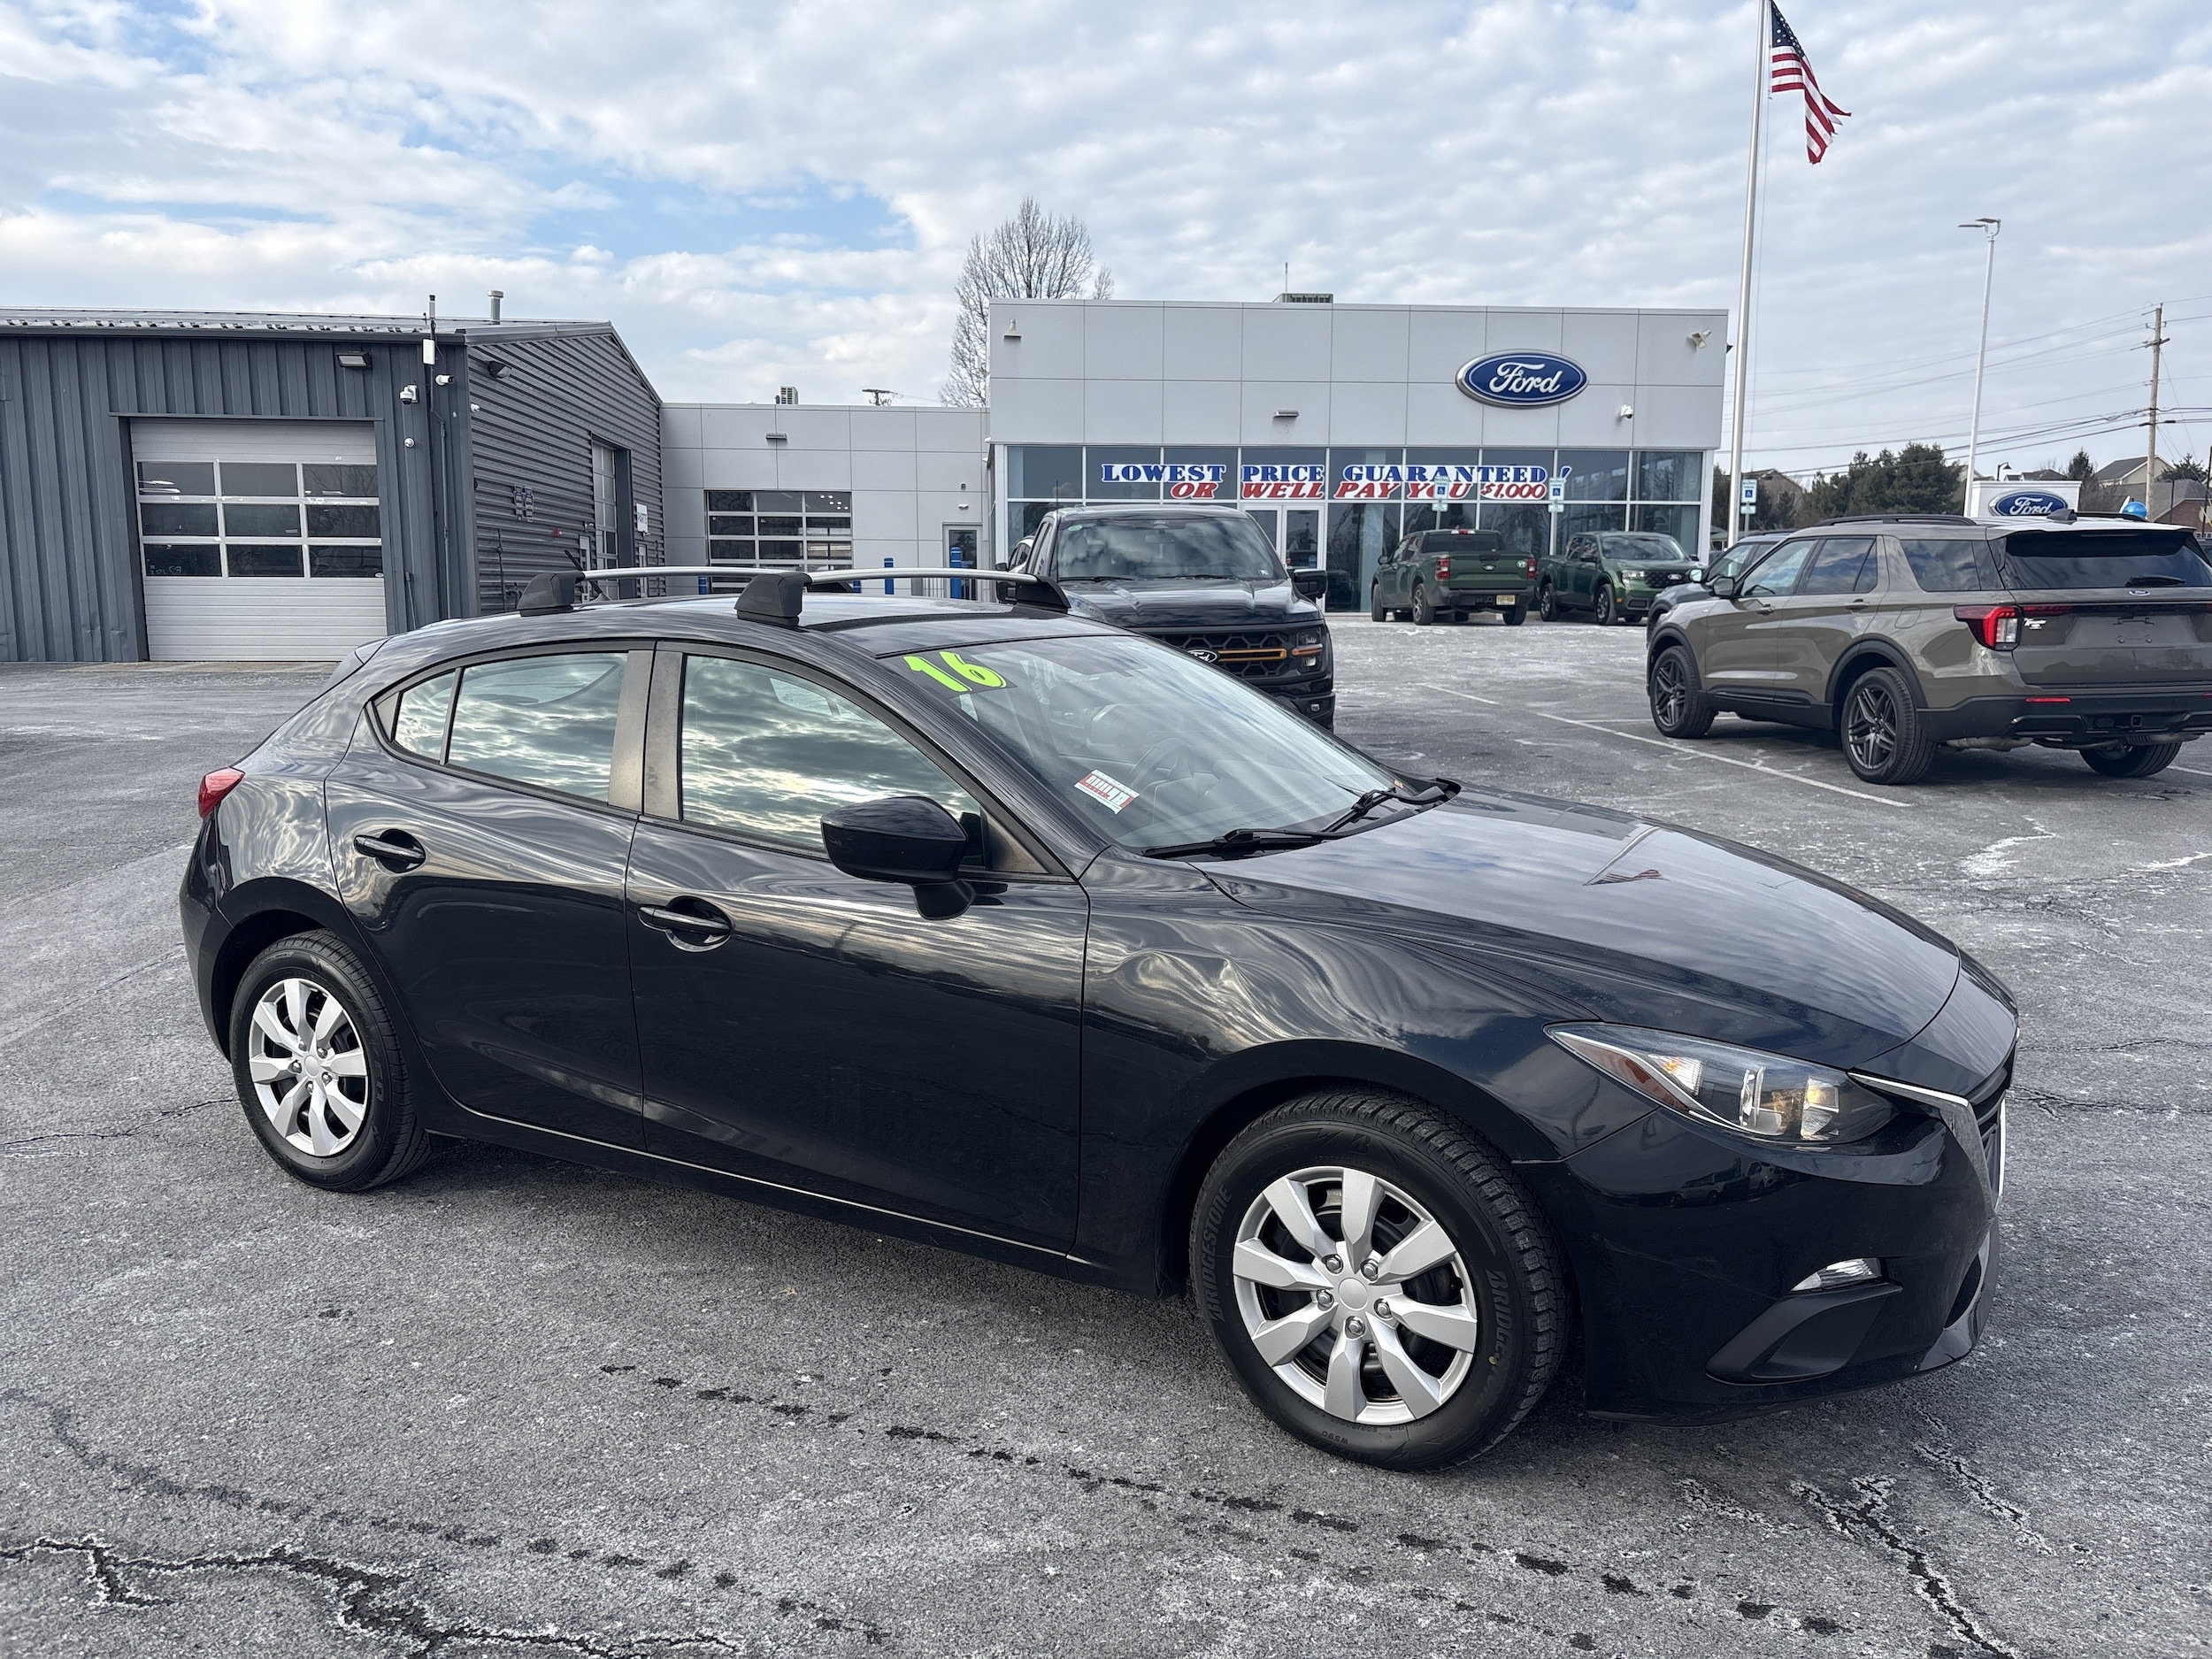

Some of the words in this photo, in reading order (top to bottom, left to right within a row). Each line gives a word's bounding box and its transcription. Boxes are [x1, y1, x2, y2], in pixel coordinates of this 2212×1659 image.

[1488, 361, 1563, 394] Ford
[1102, 465, 1226, 482] LOWEST
[1240, 465, 1325, 482] PRICE
[1171, 482, 1217, 498] OR
[1335, 482, 1401, 498] PAY
[1479, 482, 1547, 499] $1,000
[2009, 496, 2054, 515] Ford
[902, 650, 1008, 693] 16
[1201, 1184, 1233, 1323] BRIDGESTONE
[1321, 1430, 1349, 1445] WS90
